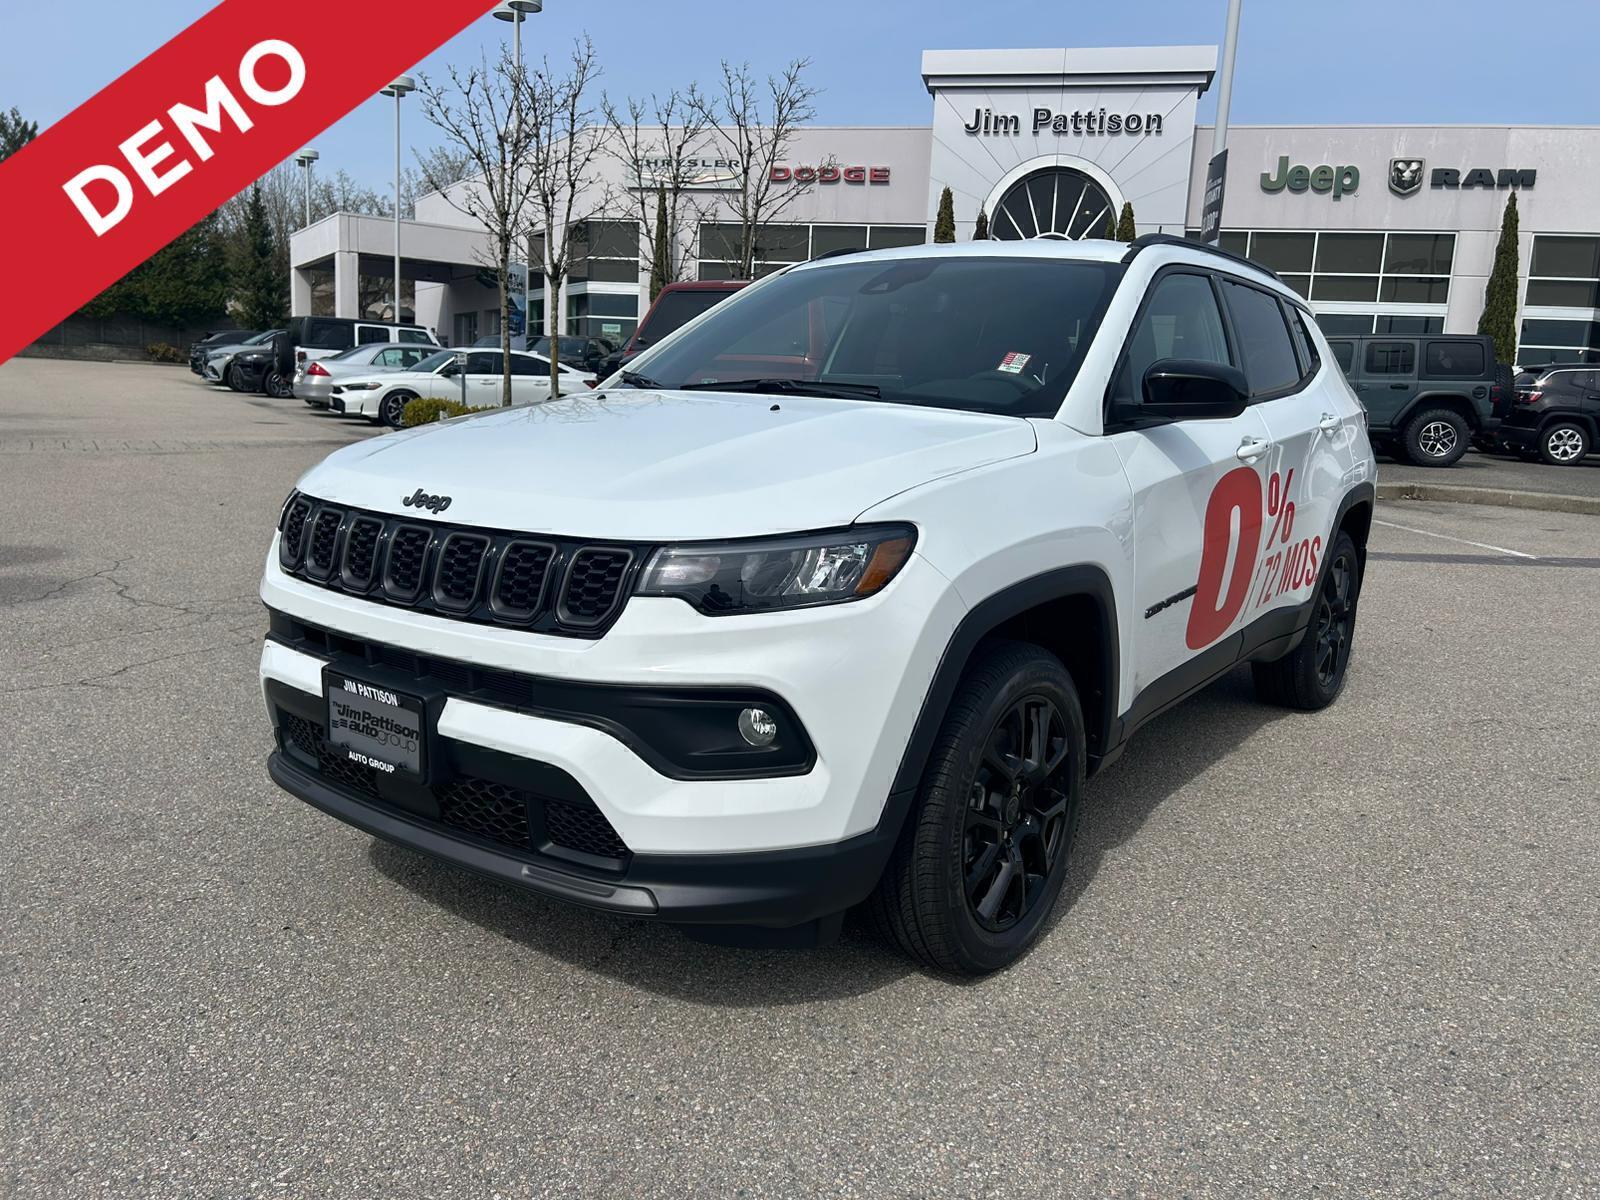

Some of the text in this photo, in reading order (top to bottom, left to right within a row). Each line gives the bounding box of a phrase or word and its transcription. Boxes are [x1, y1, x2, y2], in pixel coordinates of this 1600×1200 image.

[964, 107, 1163, 134] Jim Pattison
[770, 165, 890, 184] DODGE
[1260, 156, 1360, 201] Jeep
[1431, 168, 1537, 188] RAM
[402, 488, 452, 514] Jeep
[343, 679, 398, 707] JIM PATTISON
[348, 751, 395, 773] AUTO GROUP
